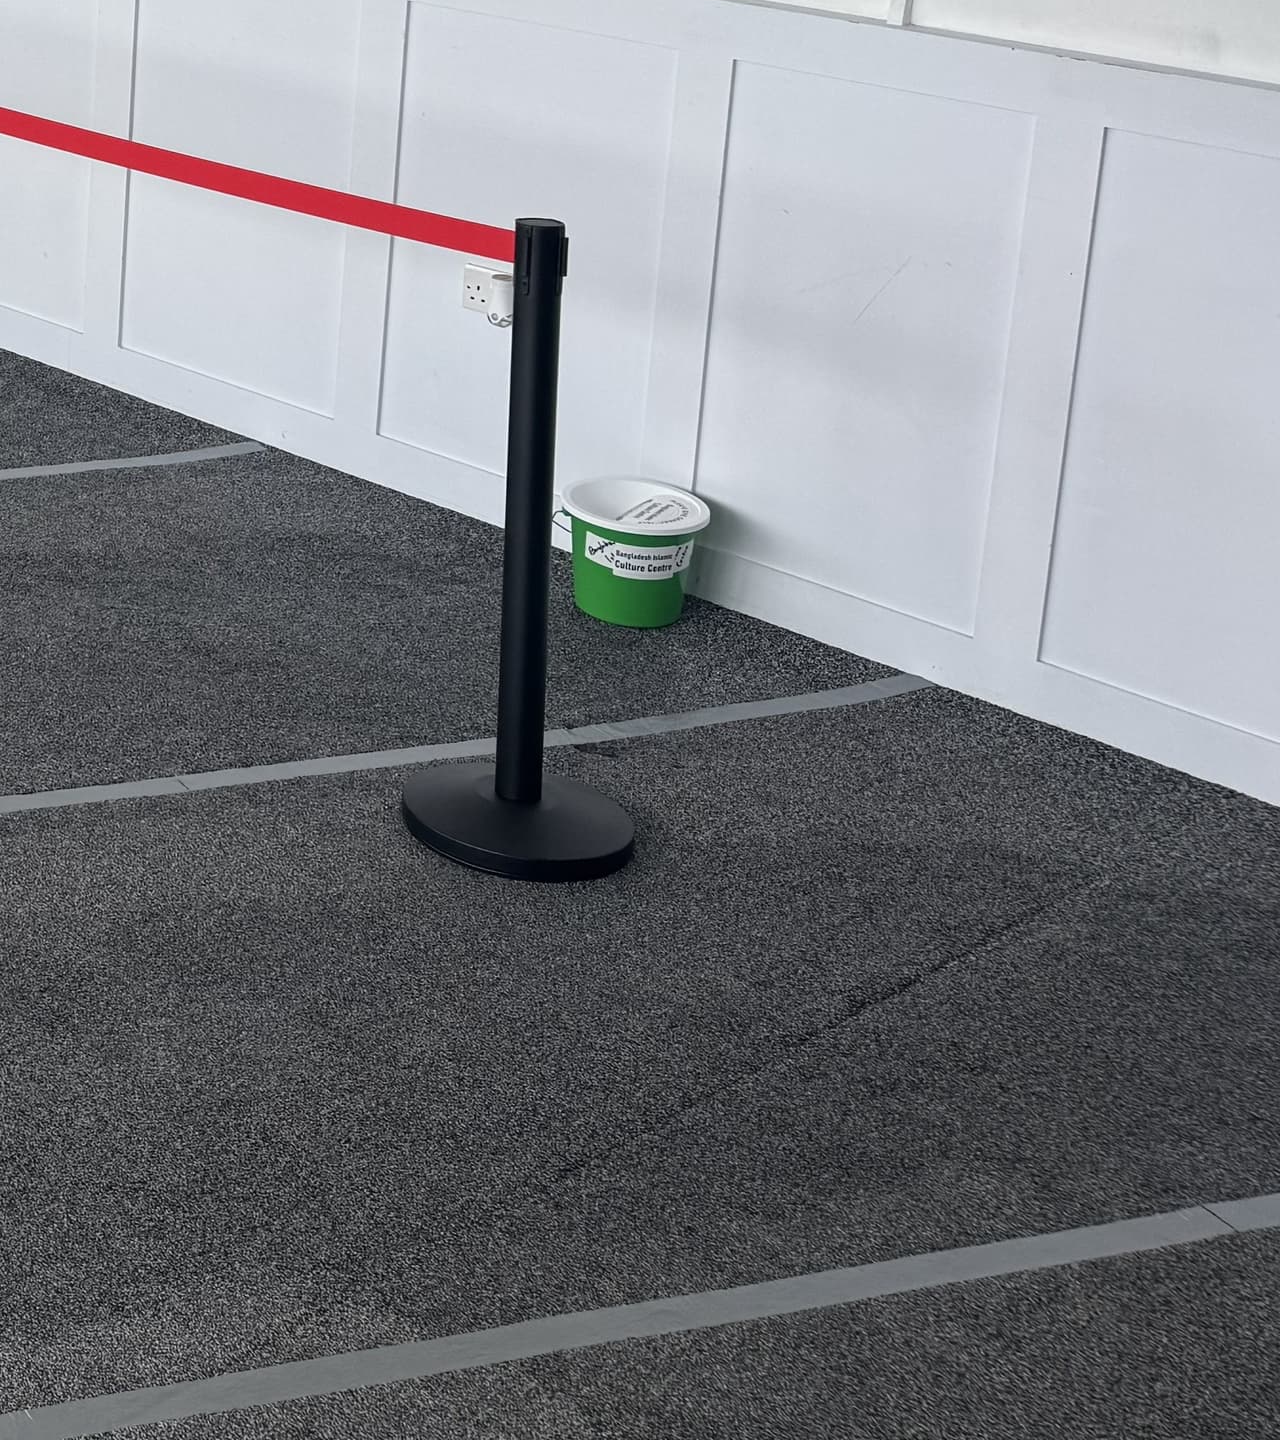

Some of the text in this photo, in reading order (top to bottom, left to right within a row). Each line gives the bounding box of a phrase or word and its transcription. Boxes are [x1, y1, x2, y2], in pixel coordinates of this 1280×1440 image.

[615, 550, 651, 561] Bangladesh
[652, 553, 673, 561] Islamic
[615, 560, 673, 573] Culture Centre
